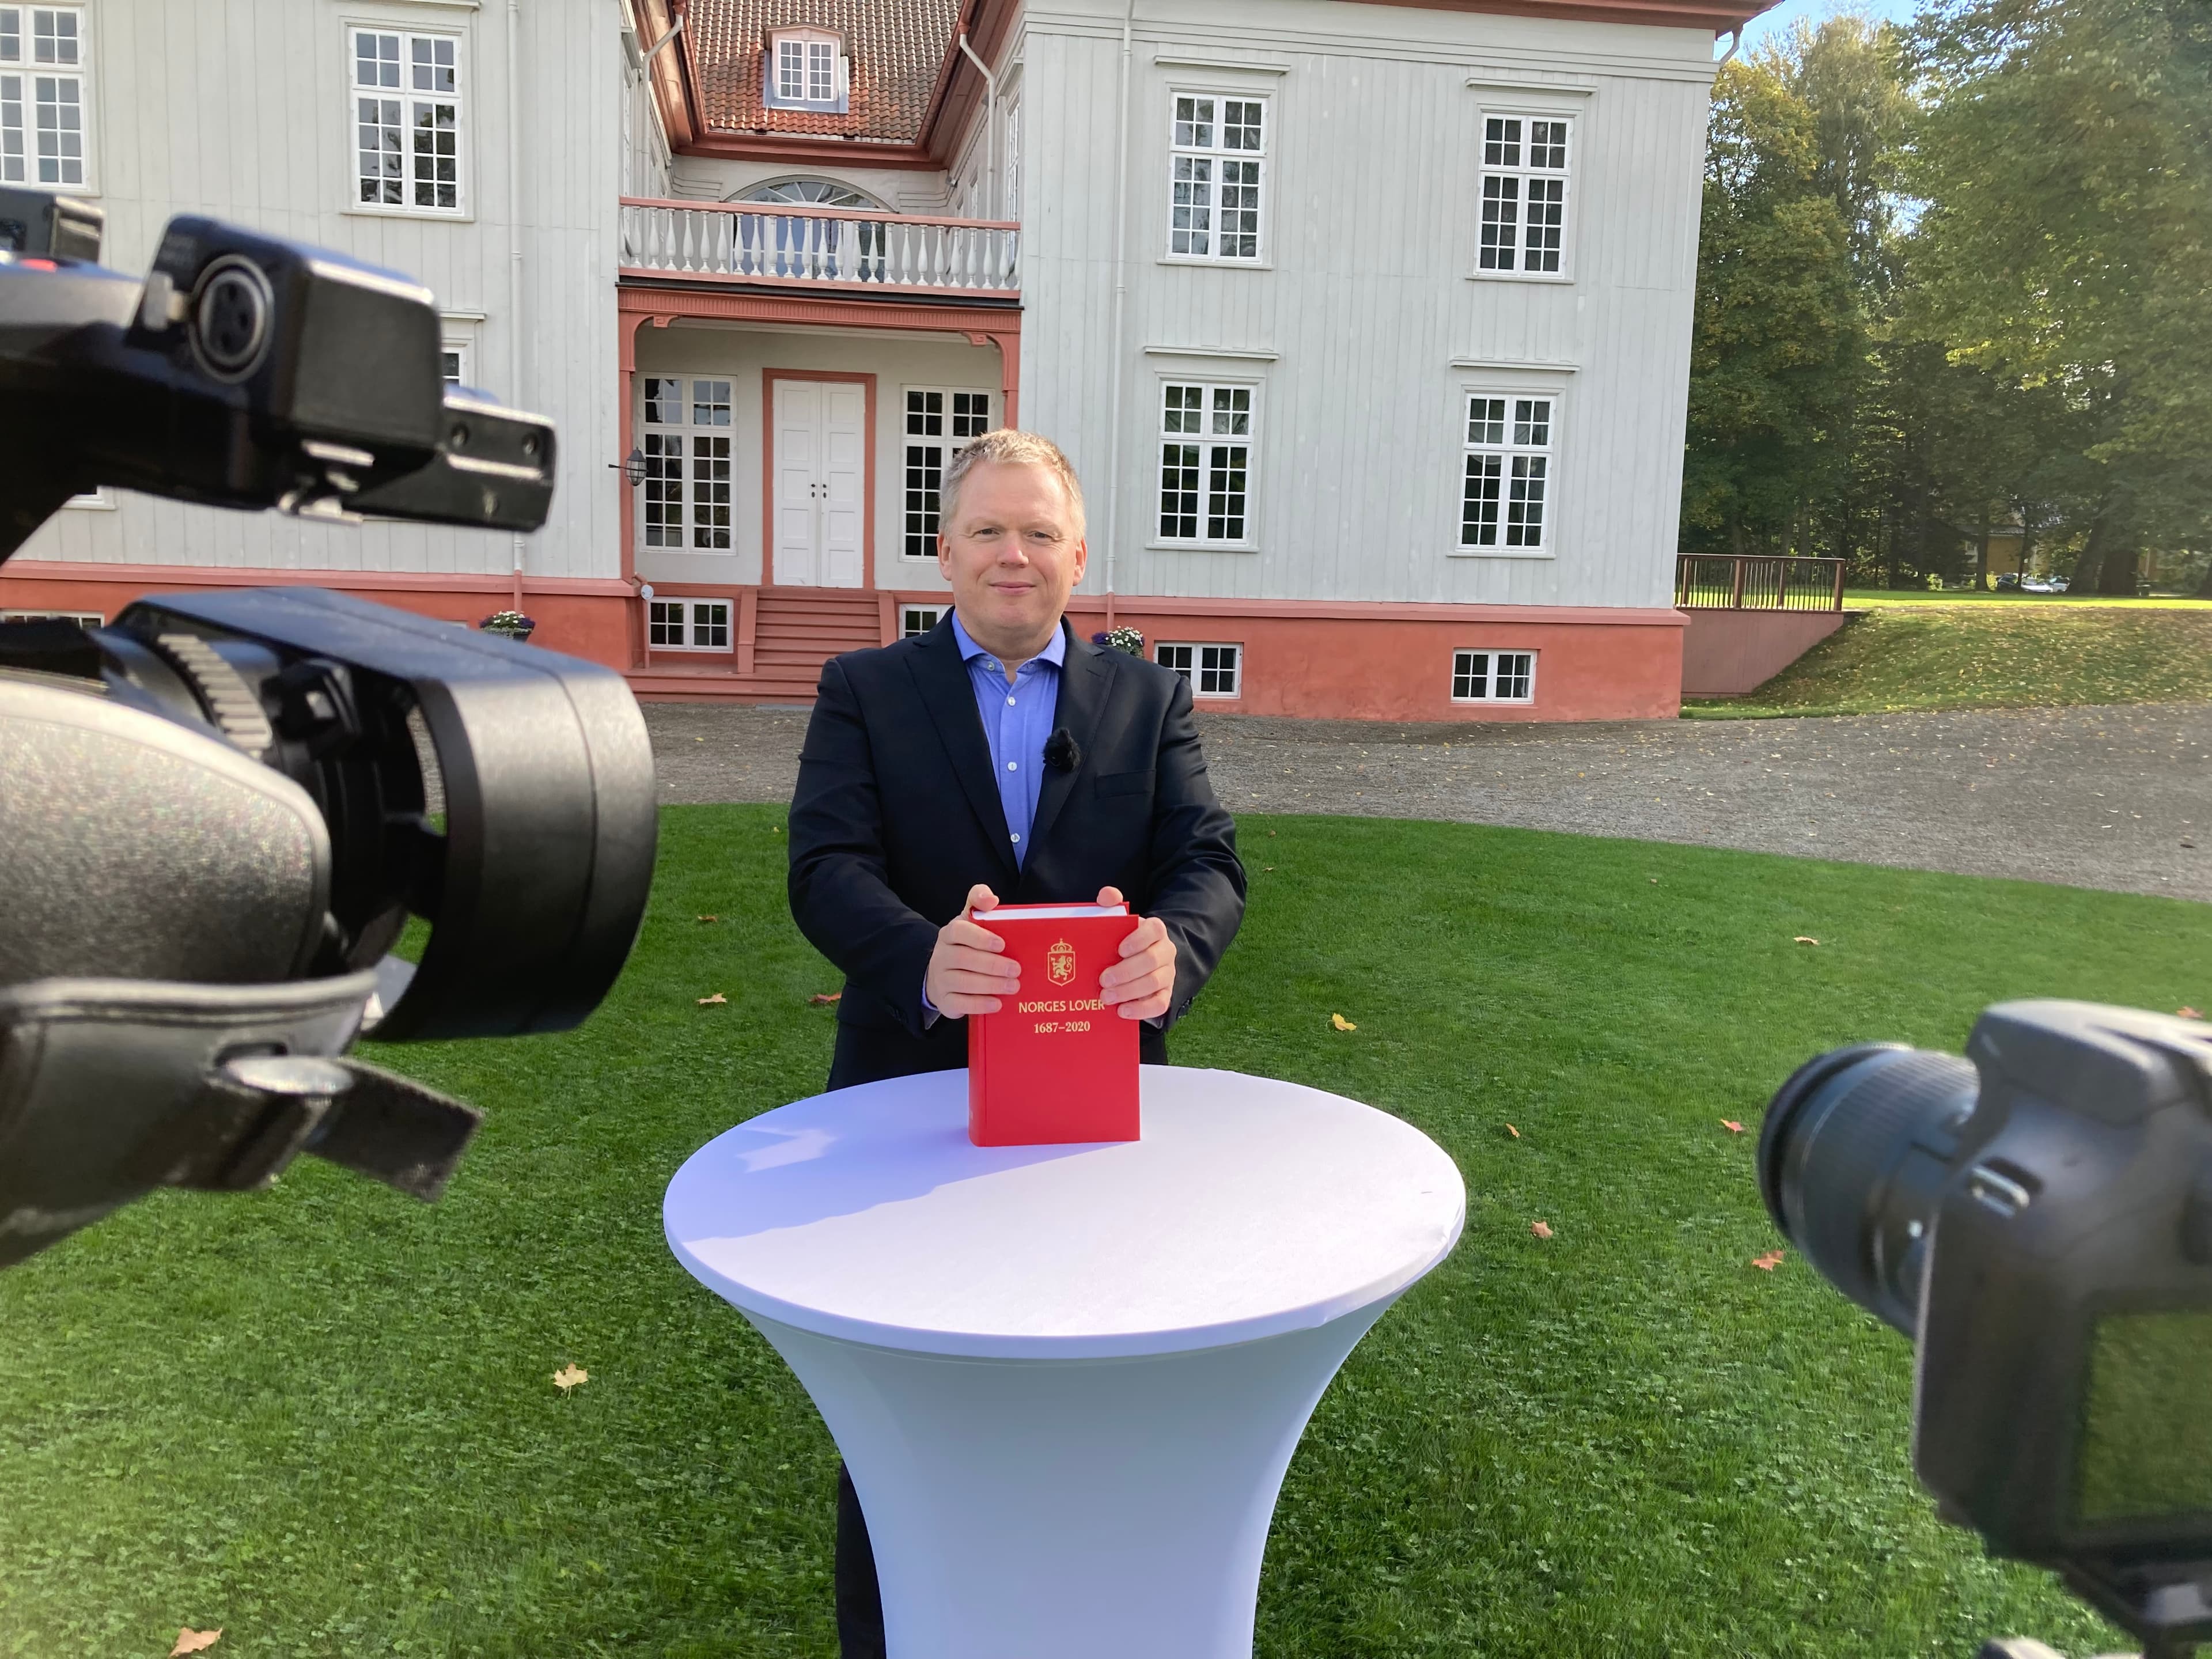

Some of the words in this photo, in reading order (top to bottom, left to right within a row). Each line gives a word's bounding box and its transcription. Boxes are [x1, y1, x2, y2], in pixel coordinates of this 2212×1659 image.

[1018, 1001, 1066, 1013] NORGES
[1069, 999, 1105, 1012] LOVER
[1033, 1021, 1090, 1033] 1687–2020
